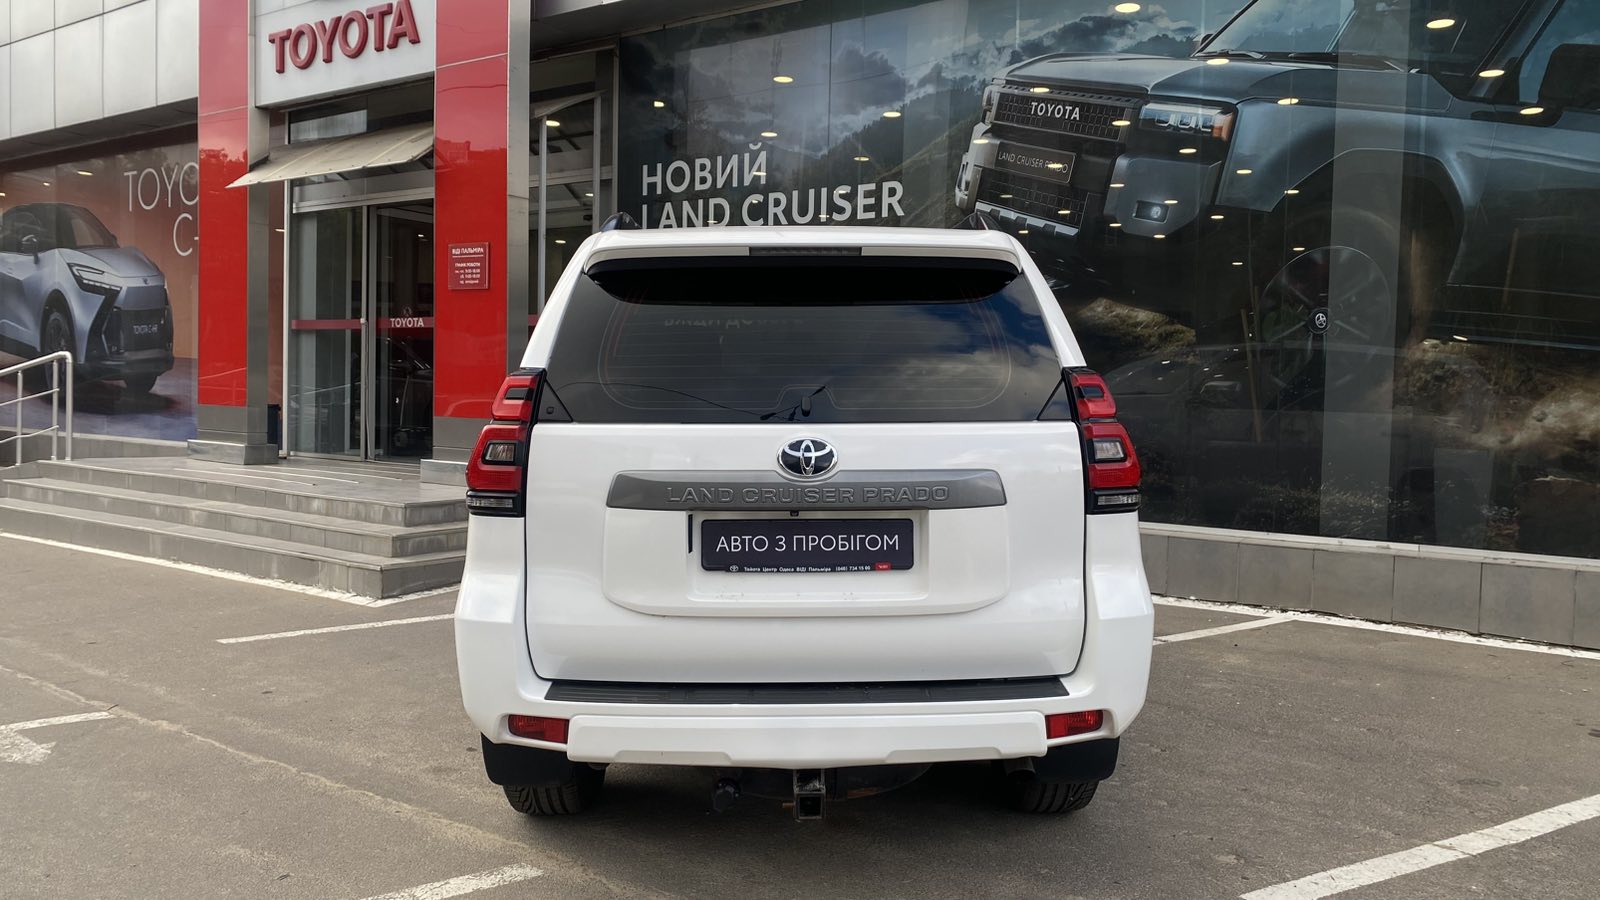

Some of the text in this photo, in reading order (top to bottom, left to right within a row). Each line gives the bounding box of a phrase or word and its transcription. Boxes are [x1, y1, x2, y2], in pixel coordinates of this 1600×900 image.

[268, 0, 421, 74] TOYOTA
[1030, 102, 1080, 120] TOYOTA
[642, 142, 767, 196] НОВИЙ
[998, 152, 1016, 162] LAND
[1016, 155, 1043, 168] CRUISER
[741, 180, 905, 227] CRUISER
[390, 317, 425, 328] TOYOTA
[665, 486, 950, 504] LAND CRUISER PRADO
[716, 535, 769, 553] АВТО
[793, 534, 900, 551] ПРОБІГОМ
